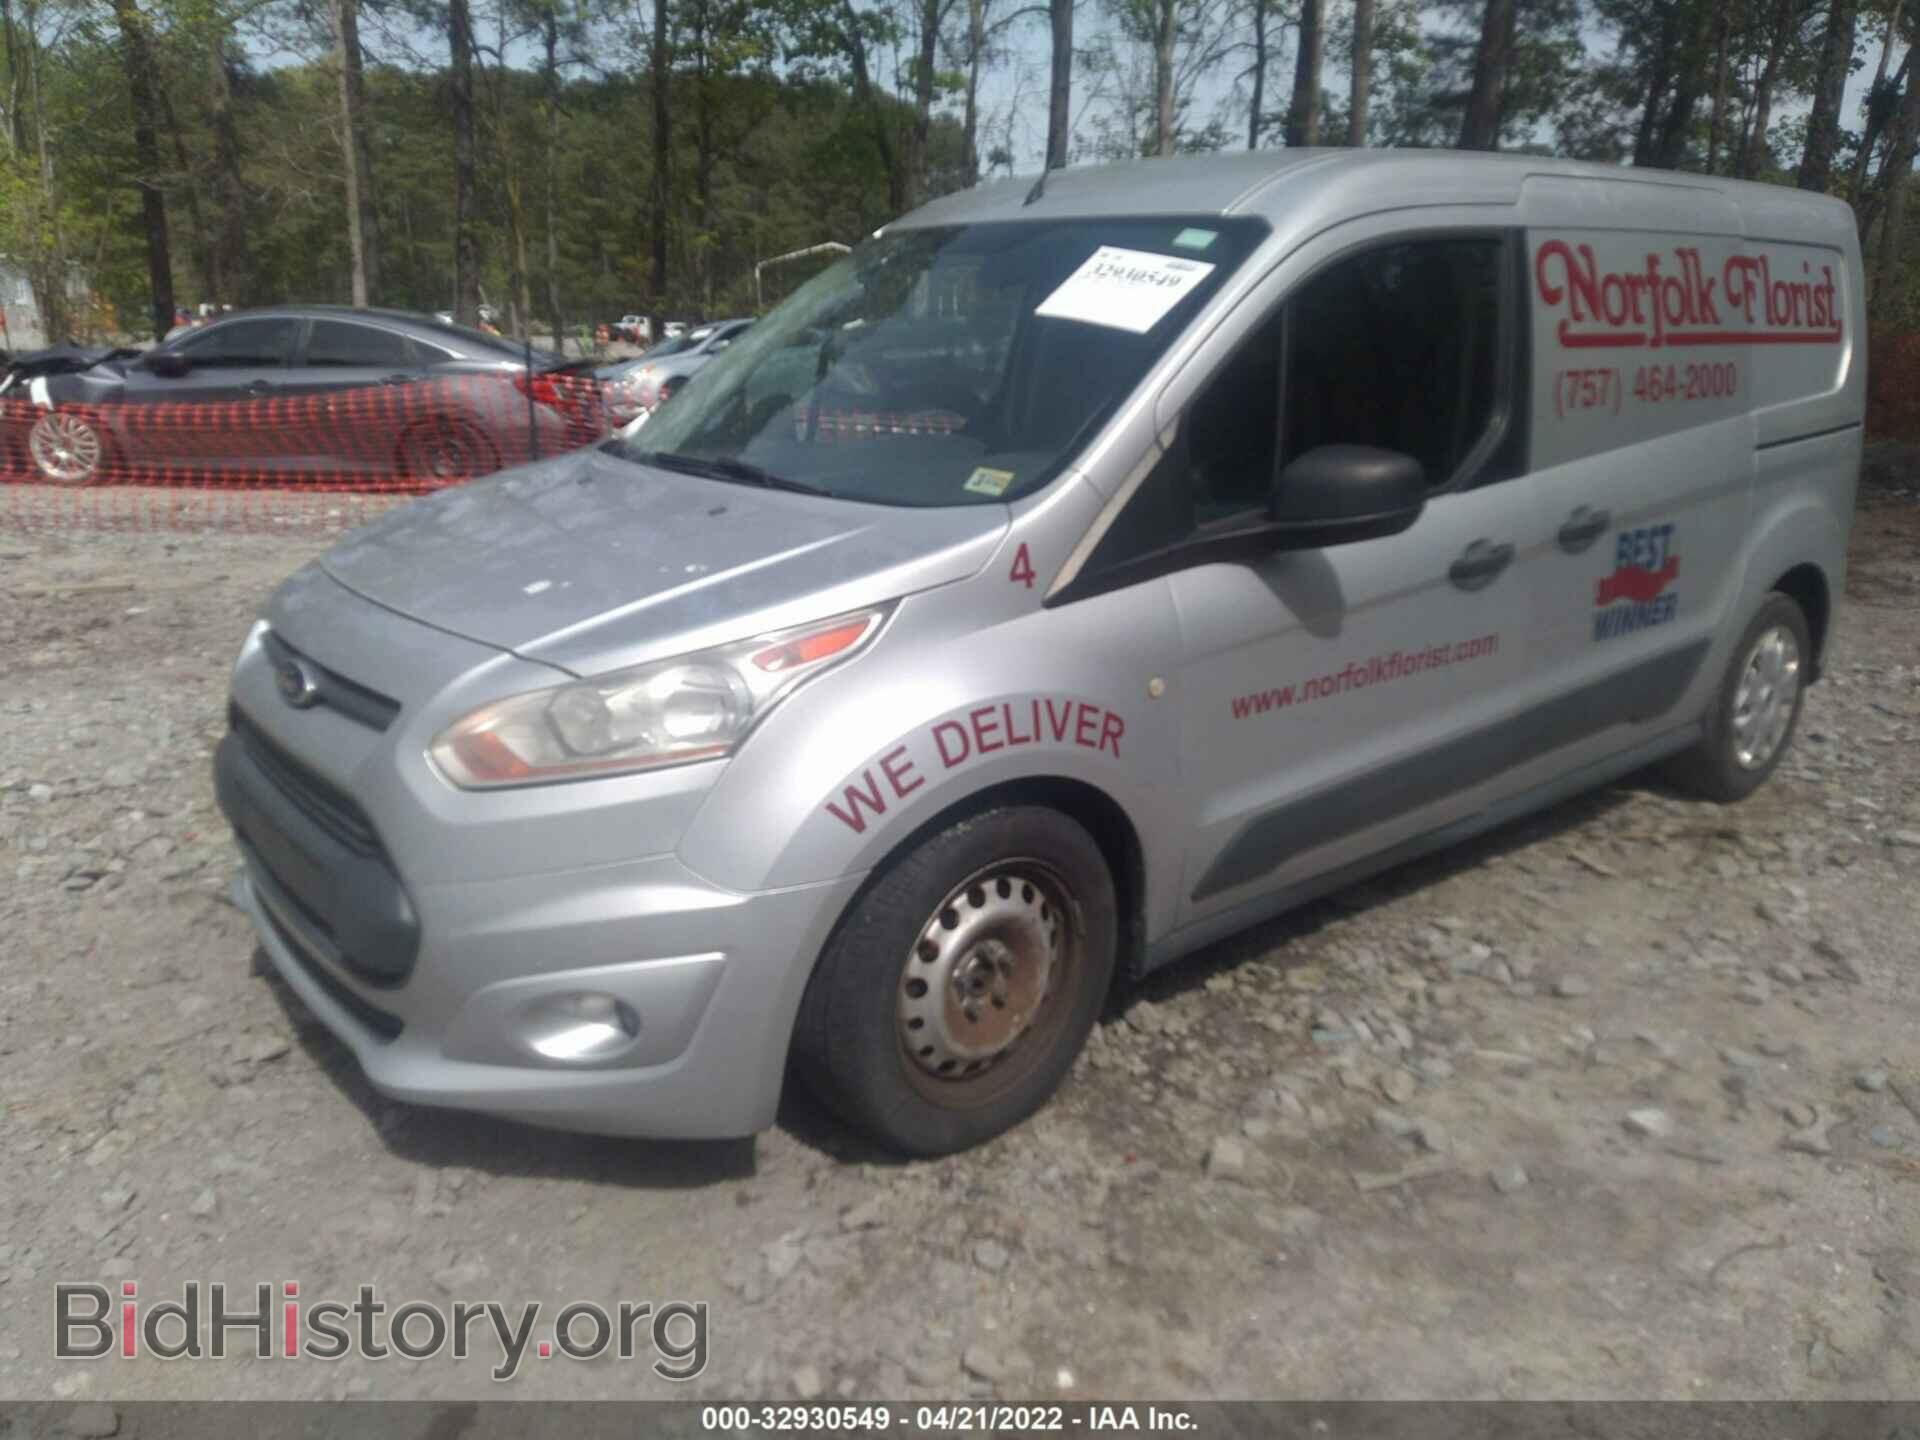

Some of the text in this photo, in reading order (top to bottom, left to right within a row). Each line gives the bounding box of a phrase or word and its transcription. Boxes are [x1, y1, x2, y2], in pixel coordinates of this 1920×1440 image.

[1536, 240, 1838, 348] Norfolk Florist
[1555, 363, 1738, 419] (757) 464-2000
[1009, 541, 1037, 589] 4
[1231, 632, 1500, 719] www.norfolkflorist.com
[825, 698, 1125, 834] WE DELIVER
